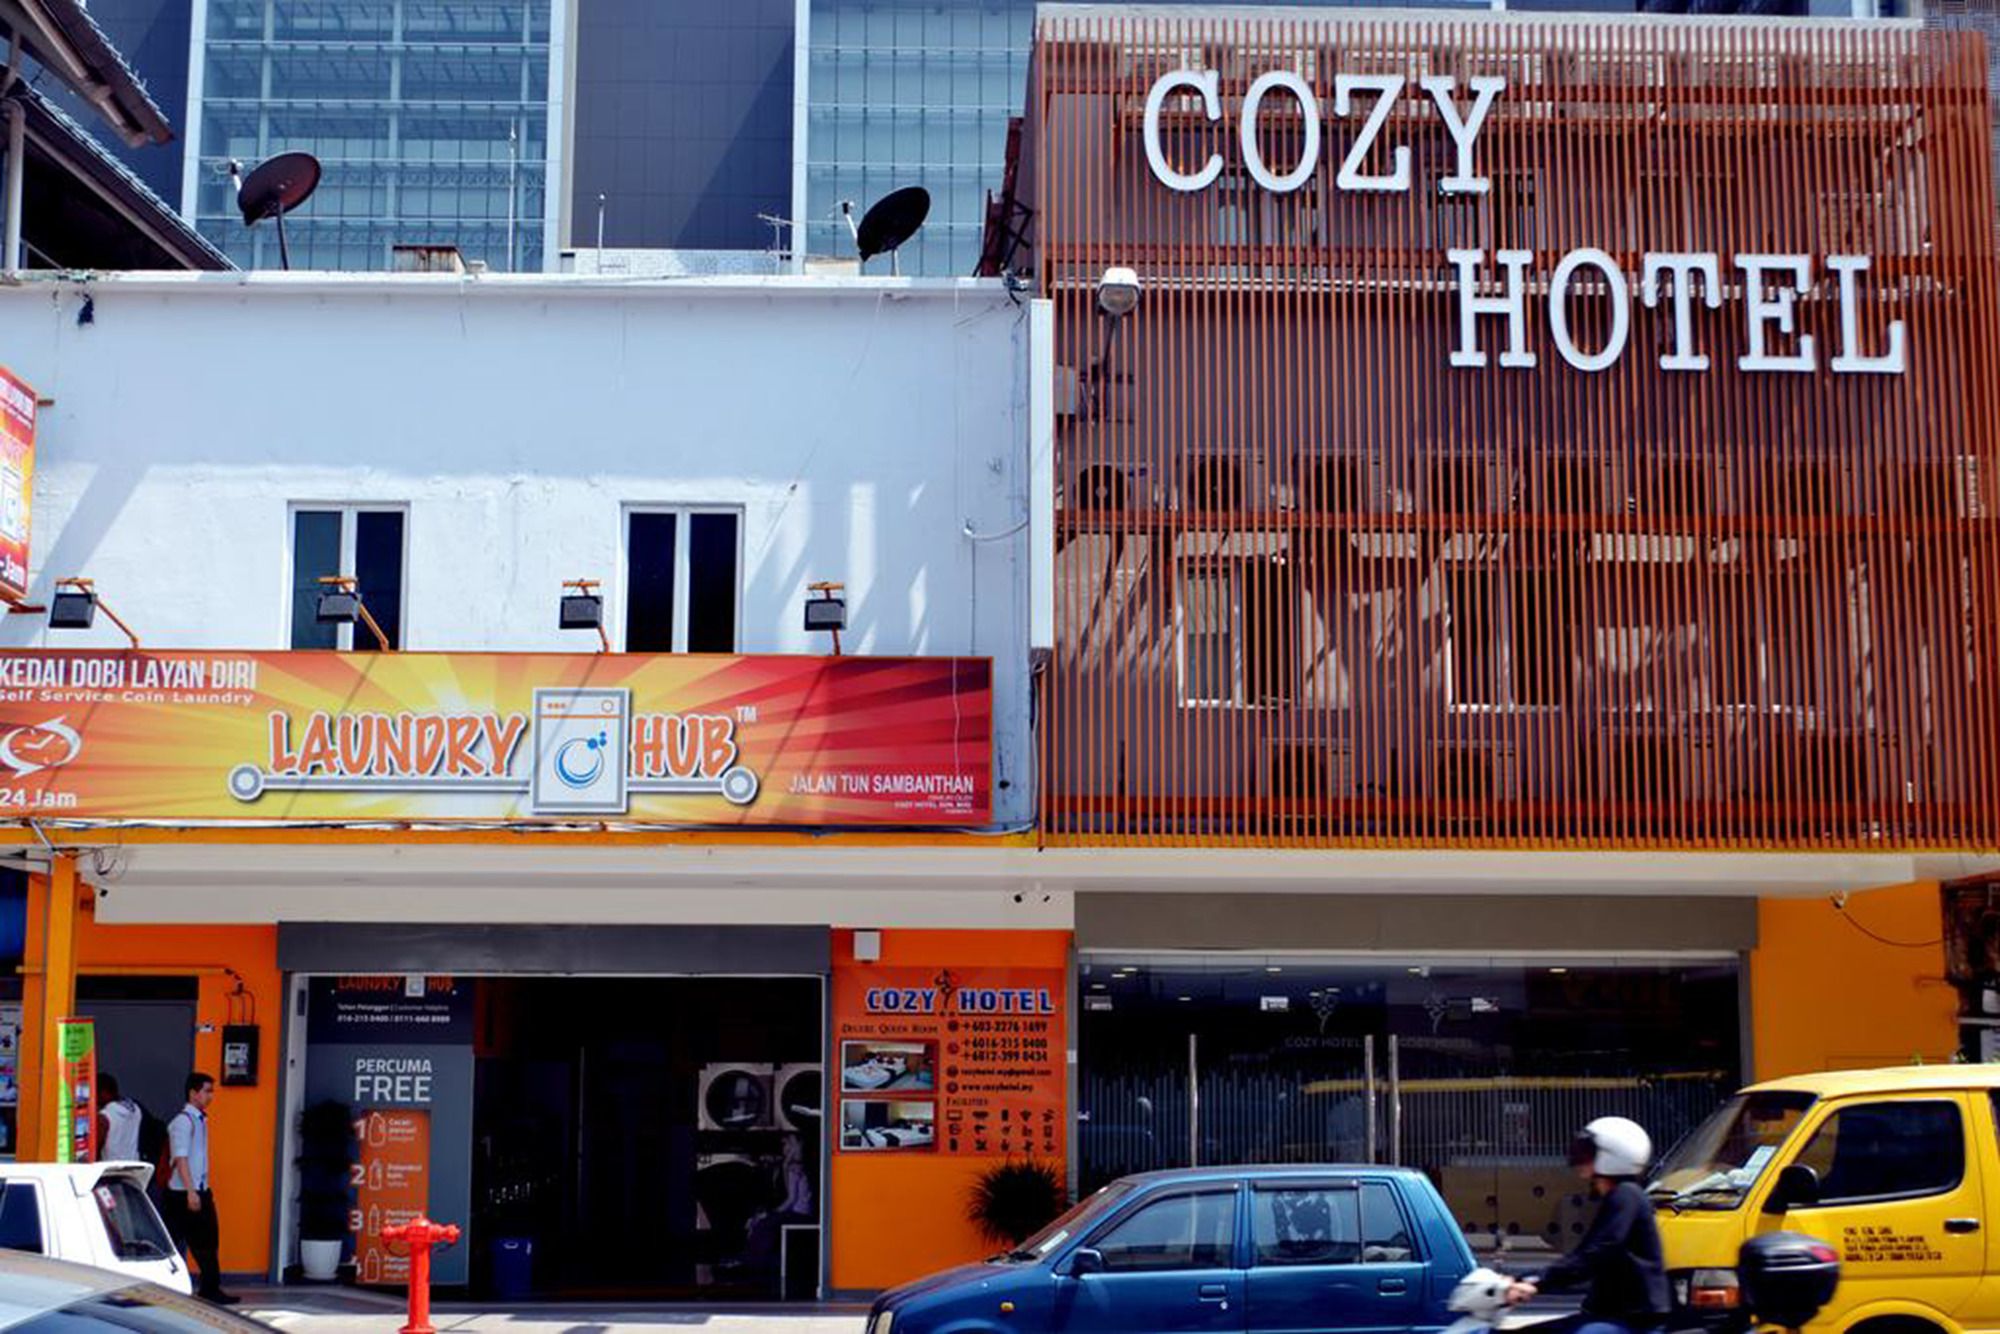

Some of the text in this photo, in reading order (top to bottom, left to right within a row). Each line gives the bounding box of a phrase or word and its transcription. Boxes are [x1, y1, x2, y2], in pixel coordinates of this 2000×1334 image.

[1143, 69, 1506, 193] COZY
[1447, 247, 1906, 374] HOTEL
[0, 658, 257, 689] KEDAI DOBI LAYAN DIRI
[40, 690, 115, 703] Service
[122, 690, 165, 703] Coin
[173, 692, 253, 706] Laundry
[269, 713, 527, 777] LAUNDRY
[630, 713, 737, 780] HUB
[789, 775, 974, 794] JALAN TUN SAMBANTHAN
[0, 788, 77, 808] 24 Jam
[866, 988, 1055, 1013] COZY HOTEL
[355, 1059, 433, 1074] PERCUMA
[354, 1075, 432, 1103] FREE
[353, 1119, 367, 1140] 1
[351, 1164, 366, 1185] 2
[350, 1209, 364, 1231] 3
